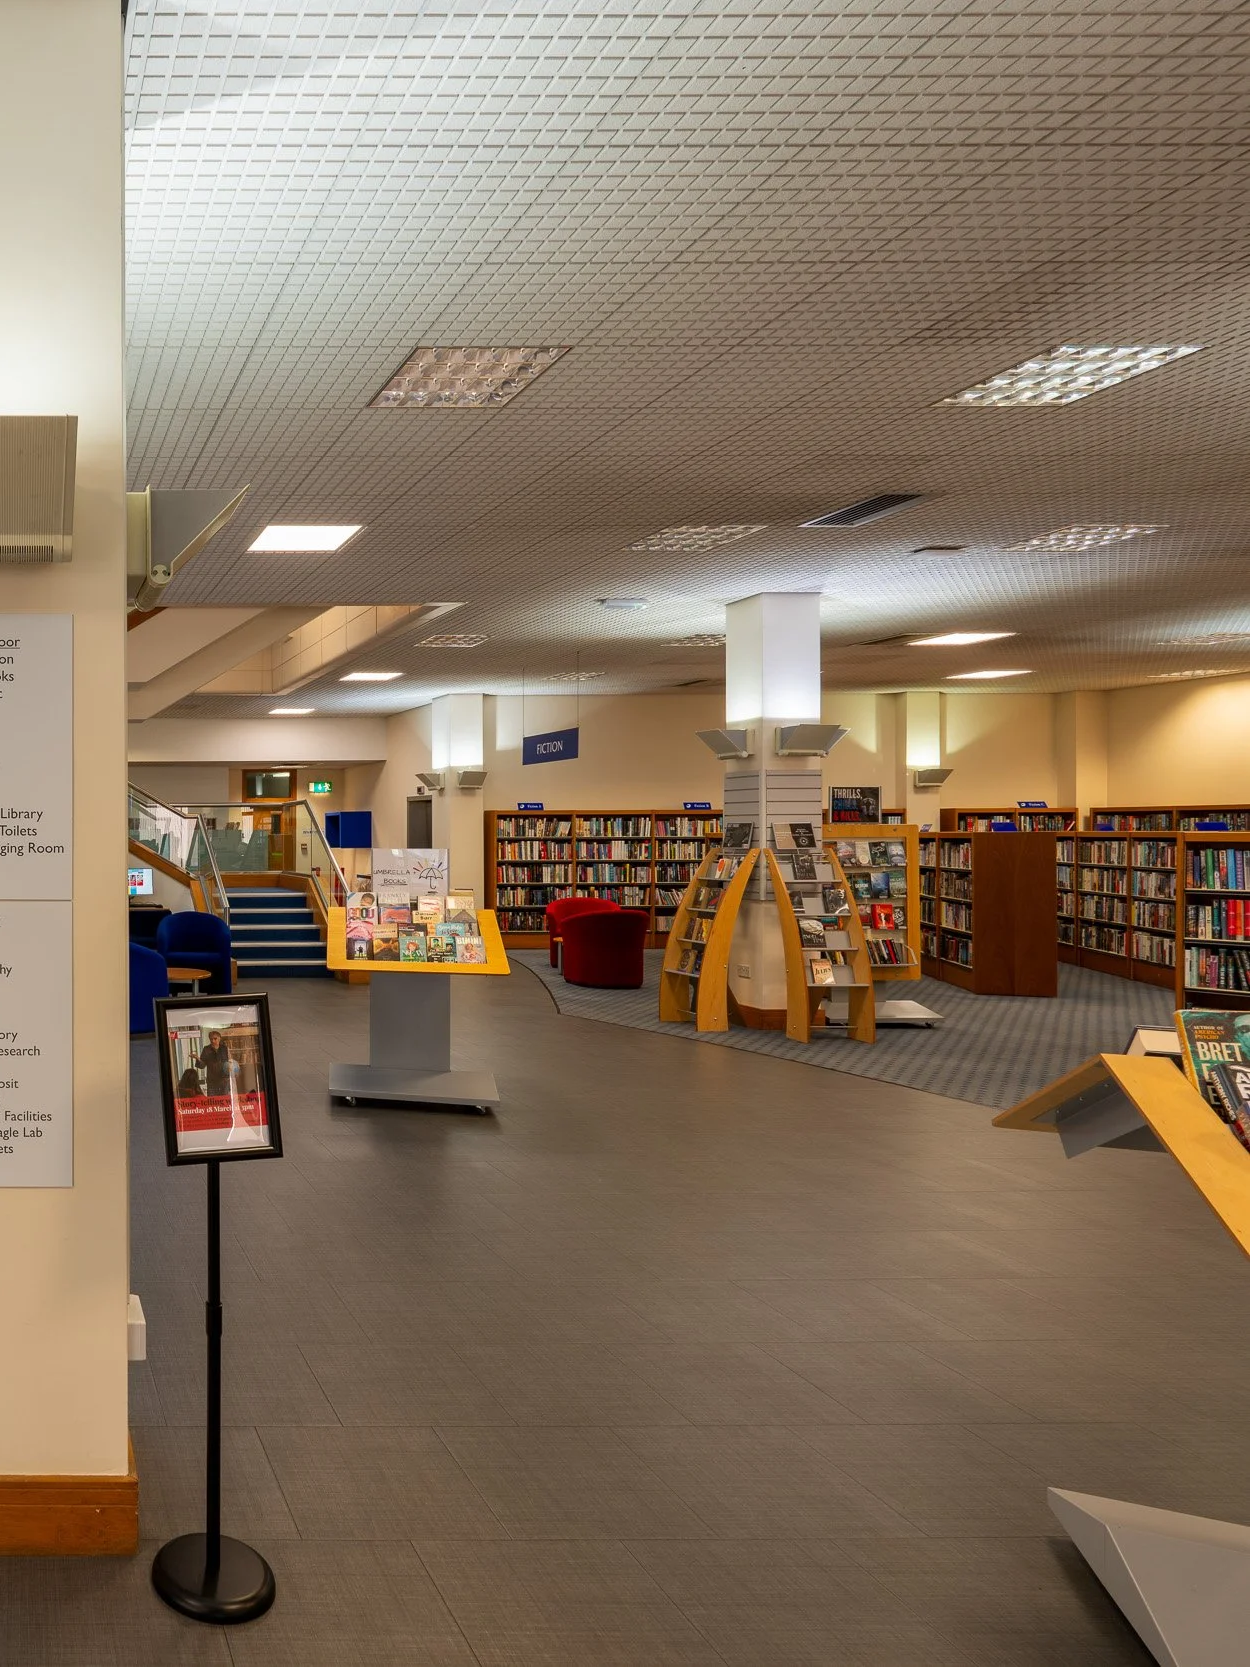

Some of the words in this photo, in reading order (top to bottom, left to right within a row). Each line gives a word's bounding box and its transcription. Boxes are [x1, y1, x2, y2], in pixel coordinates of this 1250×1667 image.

[536, 740, 563, 755] FICTION
[1, 807, 43, 822] Library
[0, 824, 37, 836] Toilets
[29, 841, 64, 854] Room
[1196, 1041, 1243, 1063] BRET
[5, 1110, 52, 1121] Facilities
[178, 1107, 205, 1115] Saturday
[24, 1126, 42, 1137] Lab
